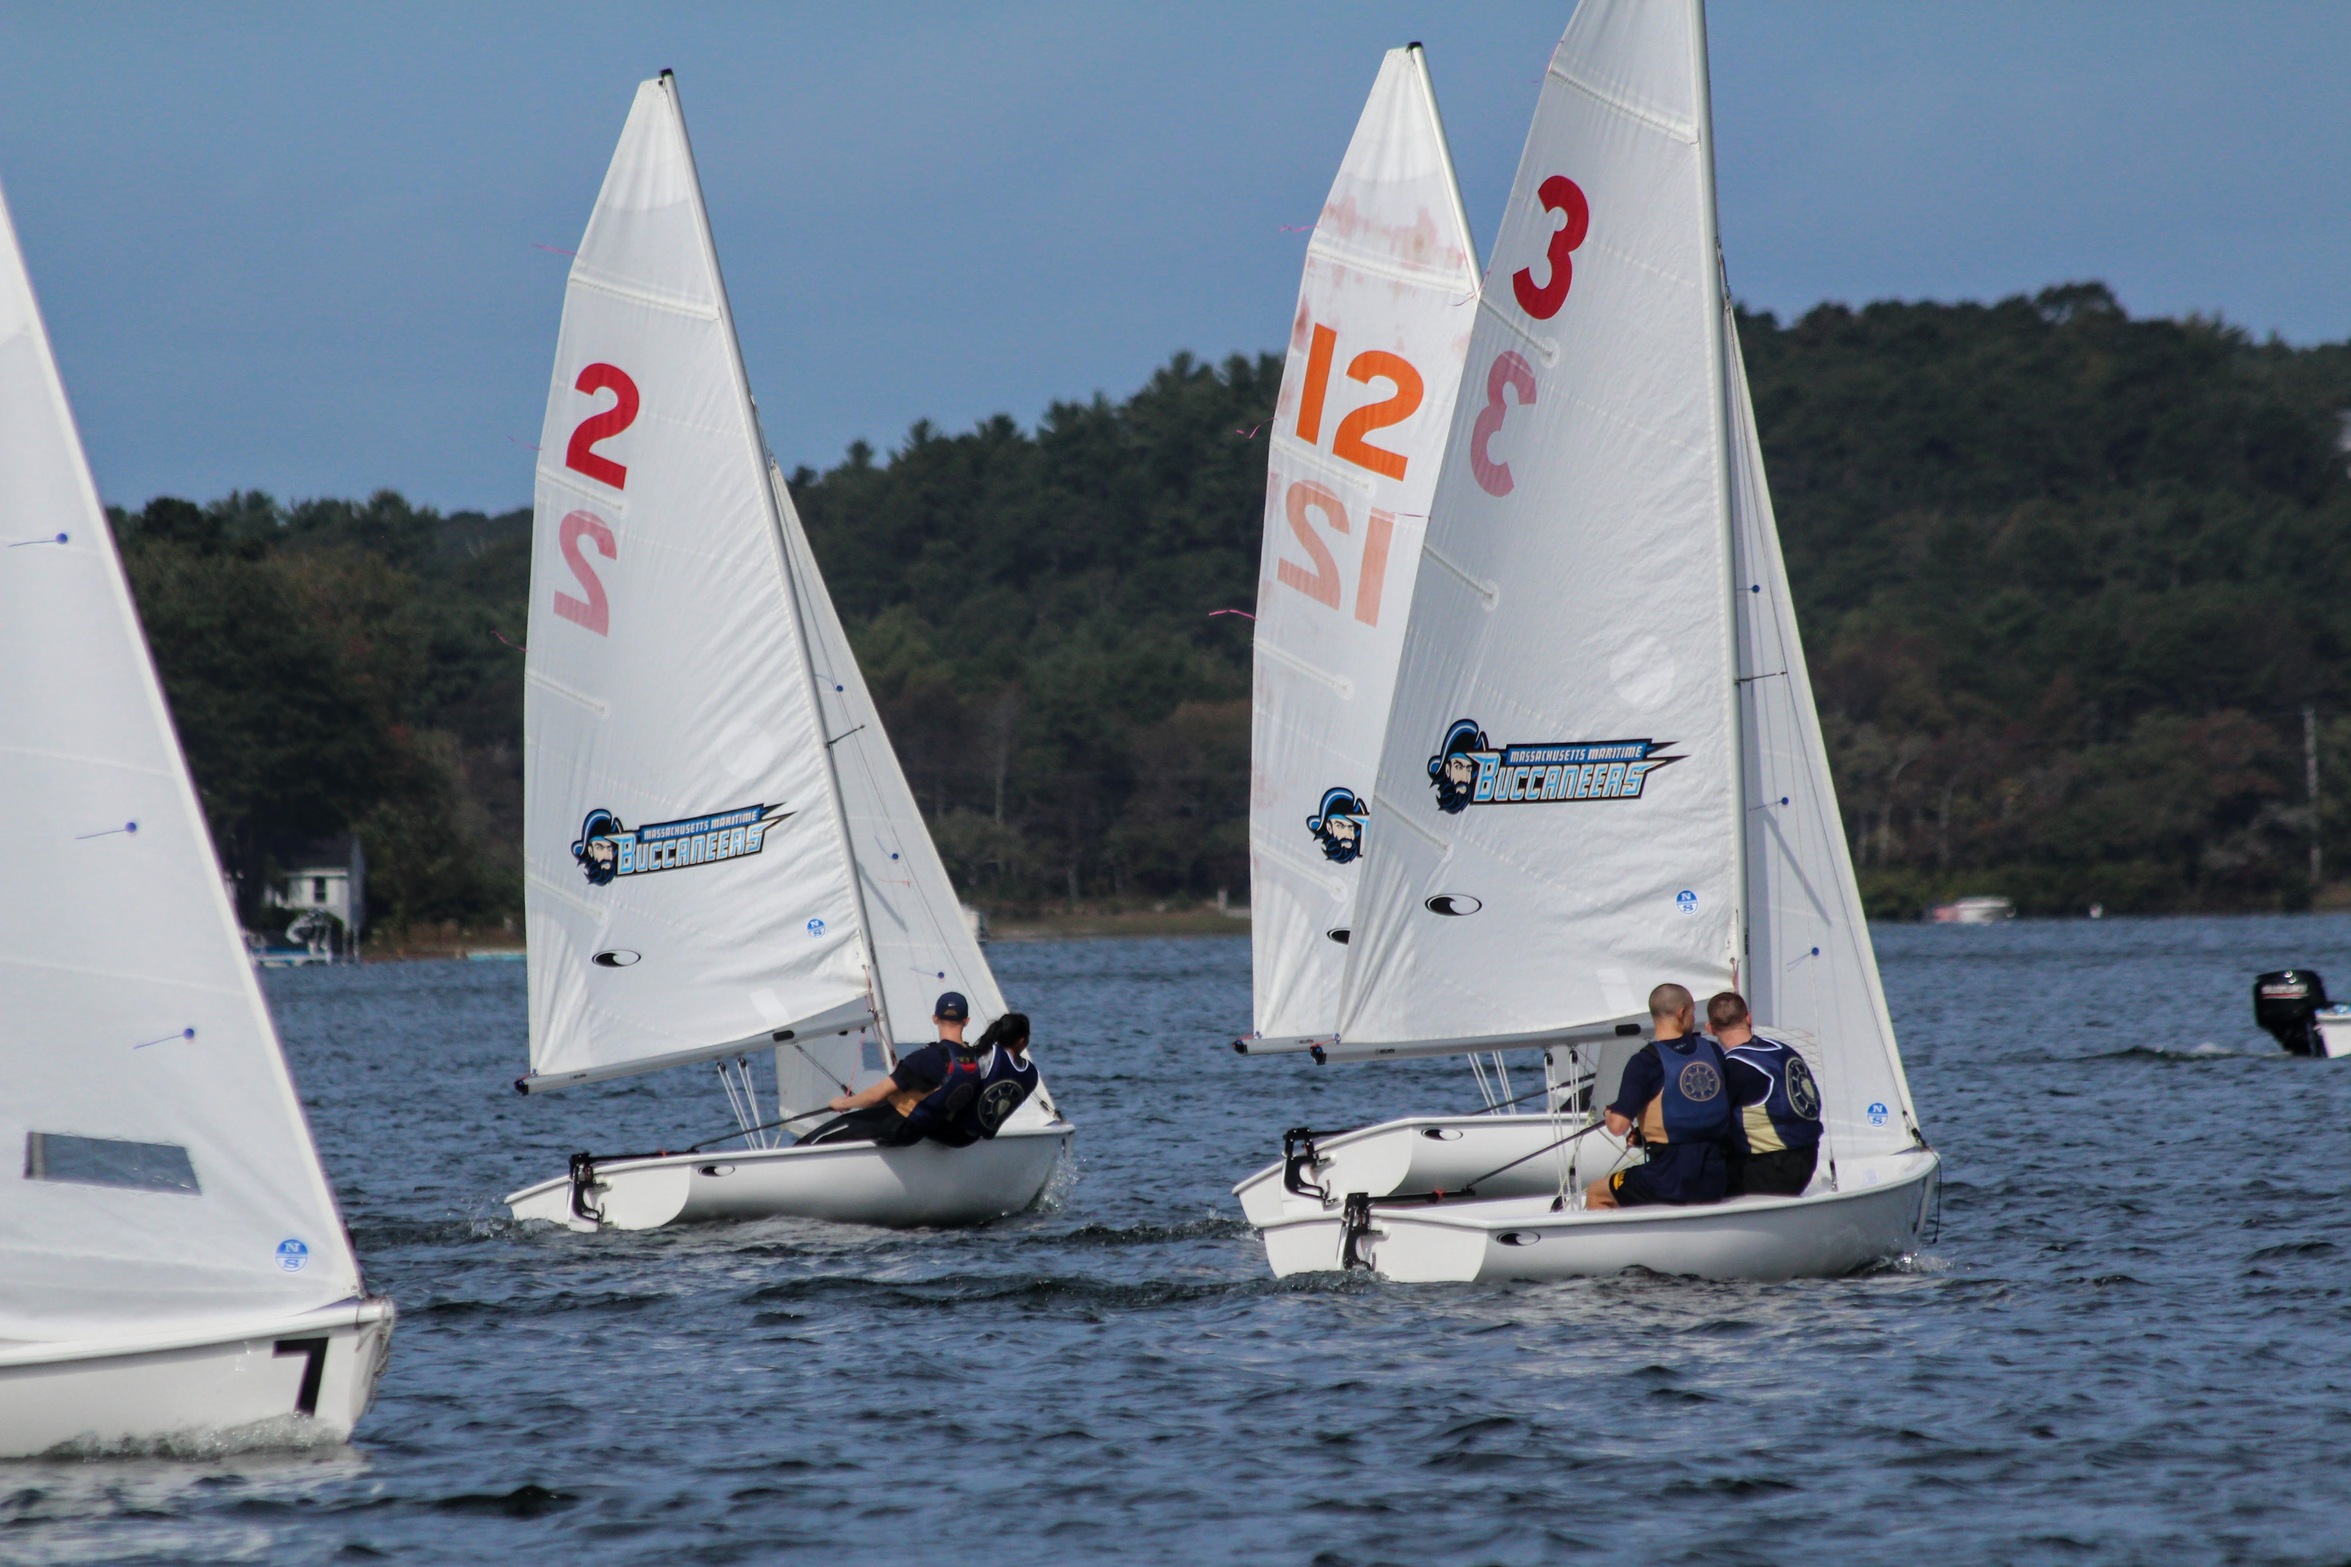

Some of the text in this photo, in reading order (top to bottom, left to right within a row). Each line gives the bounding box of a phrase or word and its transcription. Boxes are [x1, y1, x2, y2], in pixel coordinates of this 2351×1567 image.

[1512, 175, 1589, 320] 3
[565, 362, 640, 491] 2
[1296, 322, 1424, 482] 12
[1509, 745, 1643, 763] MASSACHUSETTS MARITIME
[1466, 760, 1668, 803] BUCCANEERS
[606, 817, 781, 876] BUCCANEERS
[643, 810, 758, 841] MASSACHUSETTS MARITIME
[1872, 1105, 1883, 1113] N
[284, 1242, 300, 1253] N
[272, 1337, 329, 1417] 7
